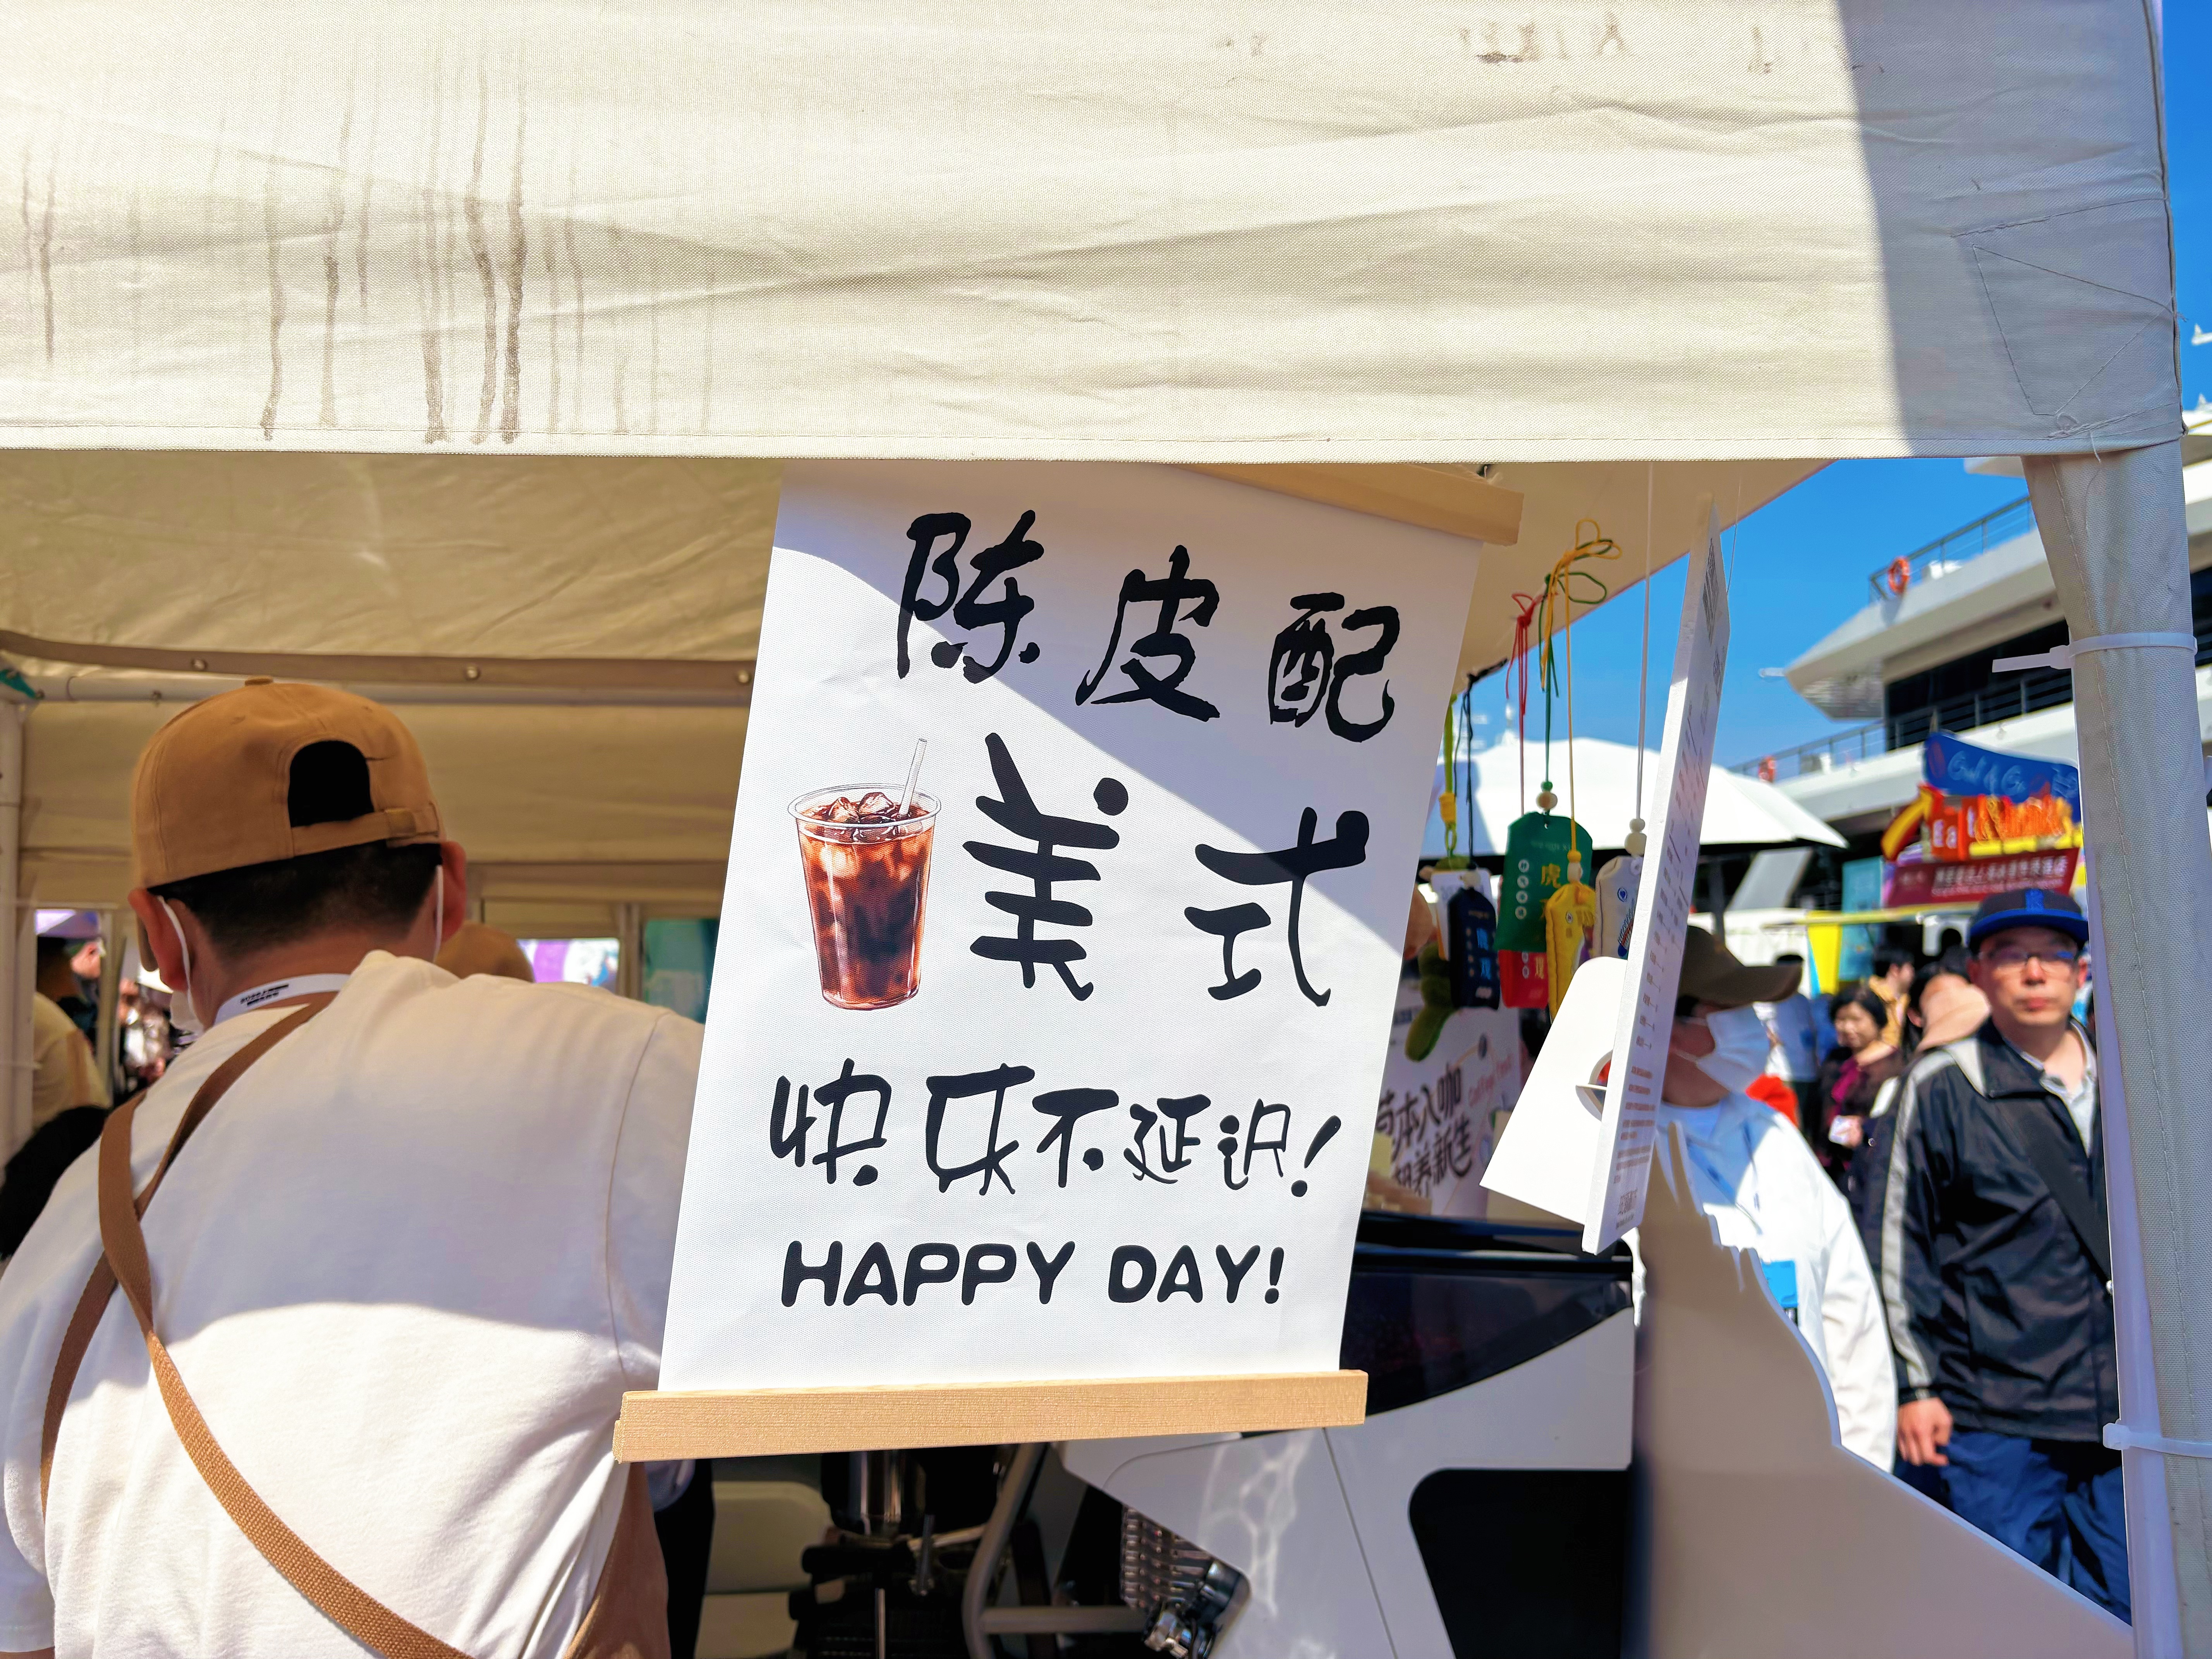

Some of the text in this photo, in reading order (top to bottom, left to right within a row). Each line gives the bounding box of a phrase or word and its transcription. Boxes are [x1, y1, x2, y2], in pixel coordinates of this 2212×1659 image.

[896, 509, 1401, 744] 陈皮配
[961, 732, 1370, 1007] 美式
[780, 1240, 1285, 1308] HAPPY DAY!
